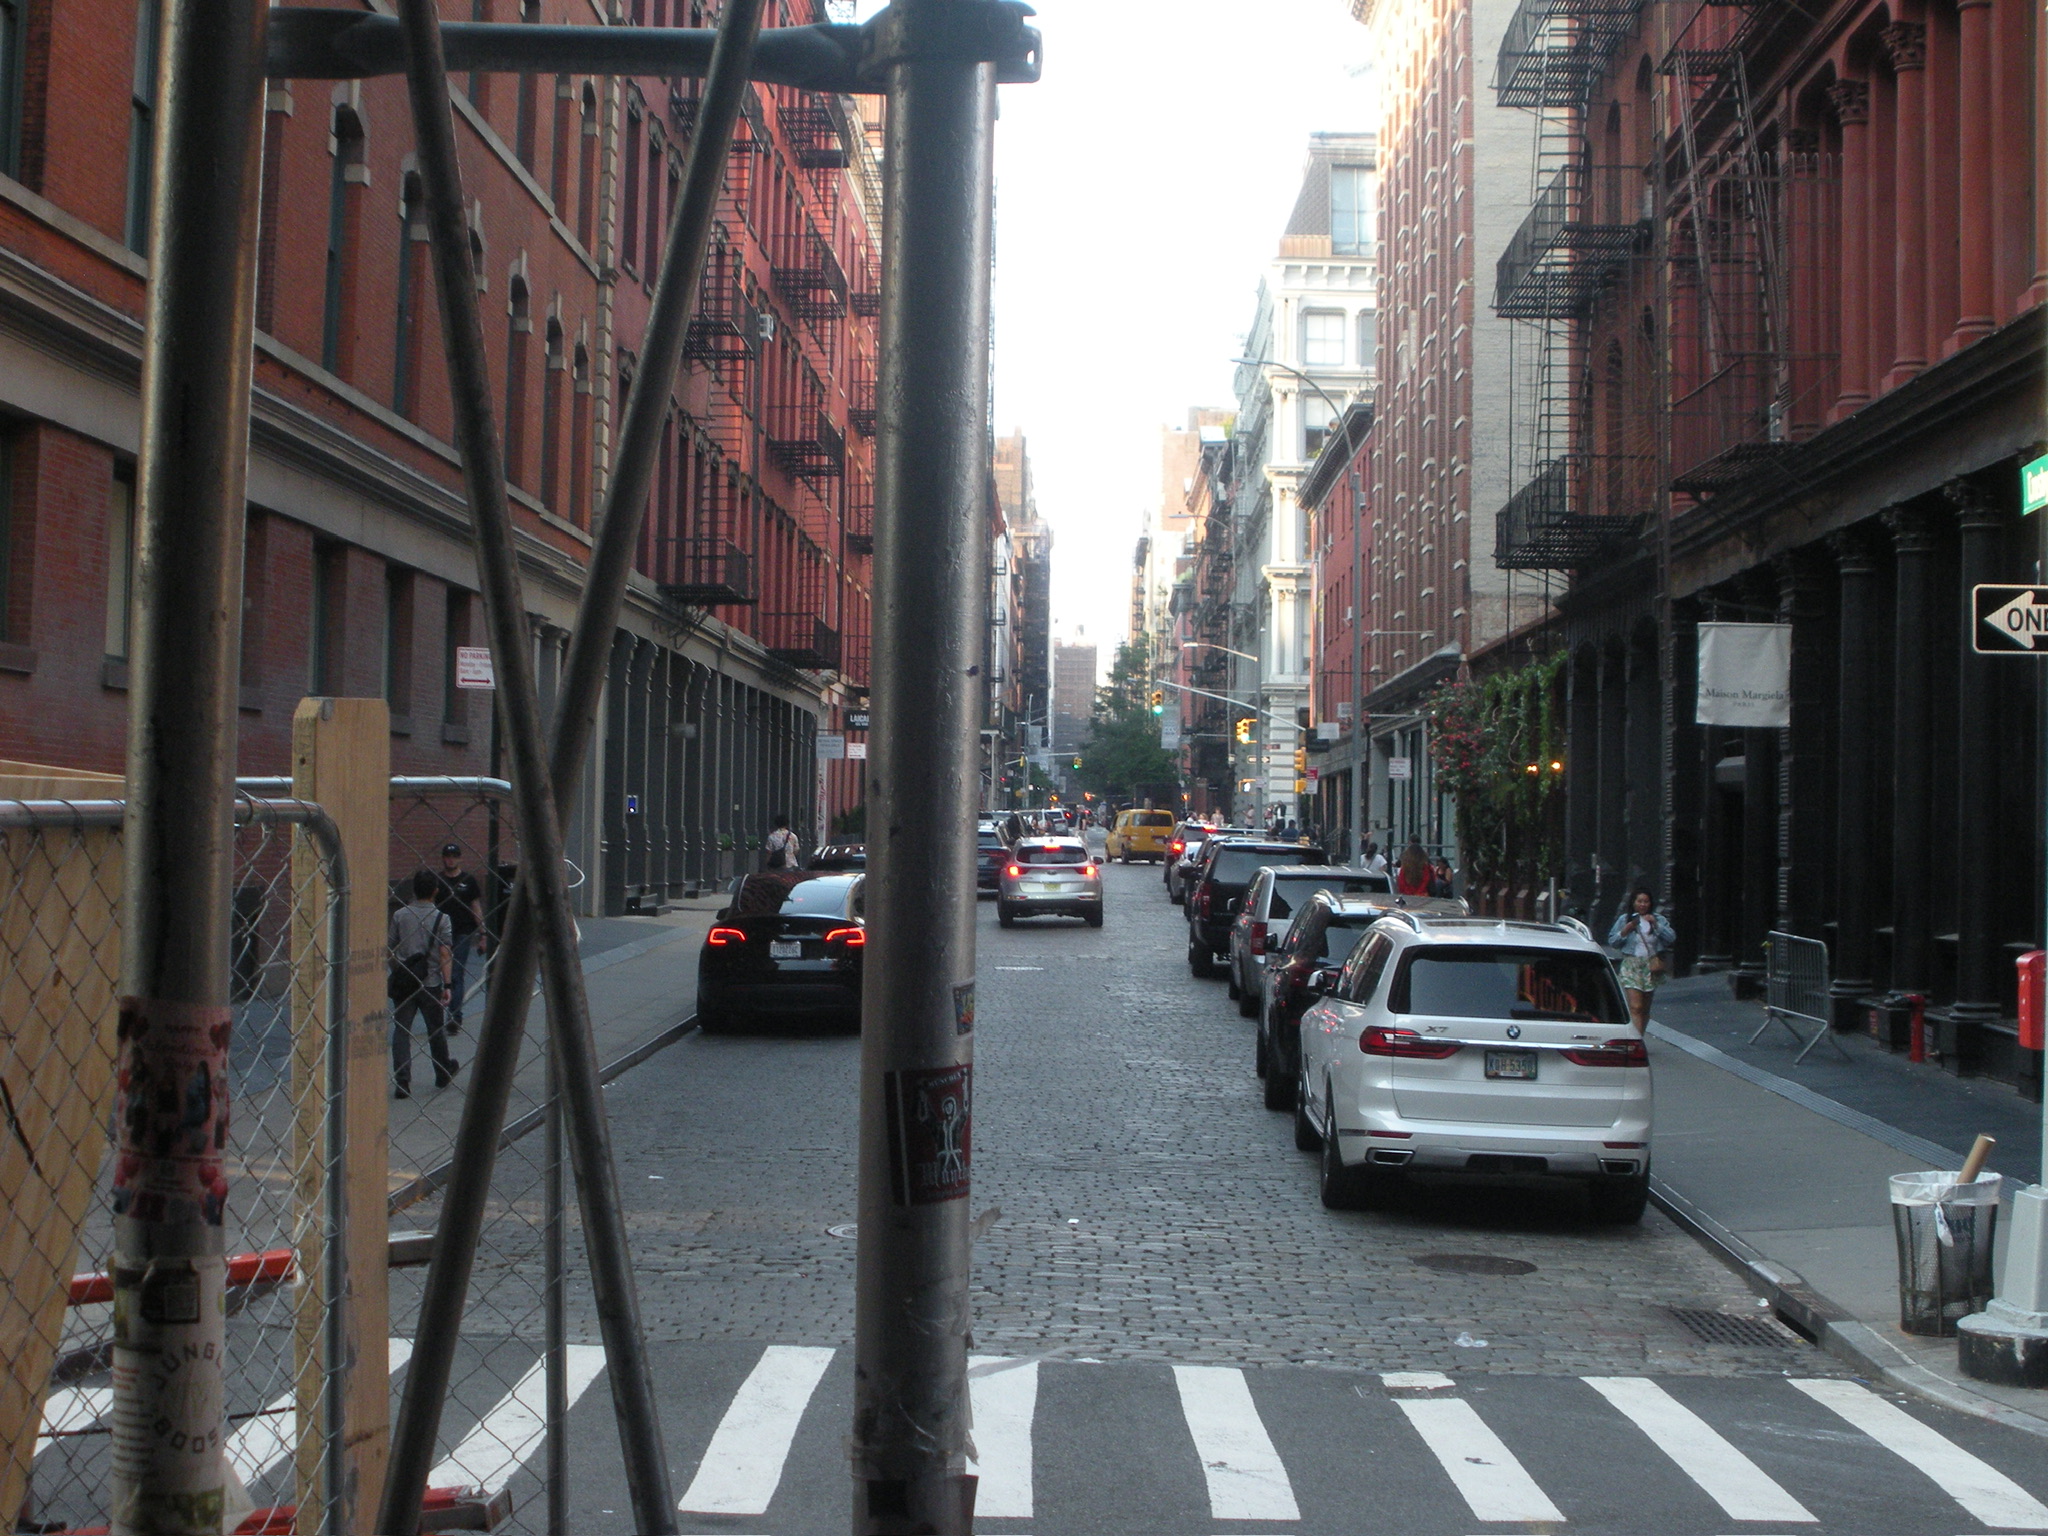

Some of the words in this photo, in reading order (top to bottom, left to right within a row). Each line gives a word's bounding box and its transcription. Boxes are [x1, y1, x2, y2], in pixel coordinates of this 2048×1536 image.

[469, 652, 491, 660] PARKIN
[1705, 688, 1738, 698] Maison
[1742, 689, 1784, 701] Margiela
[1425, 1025, 1449, 1033] X7
